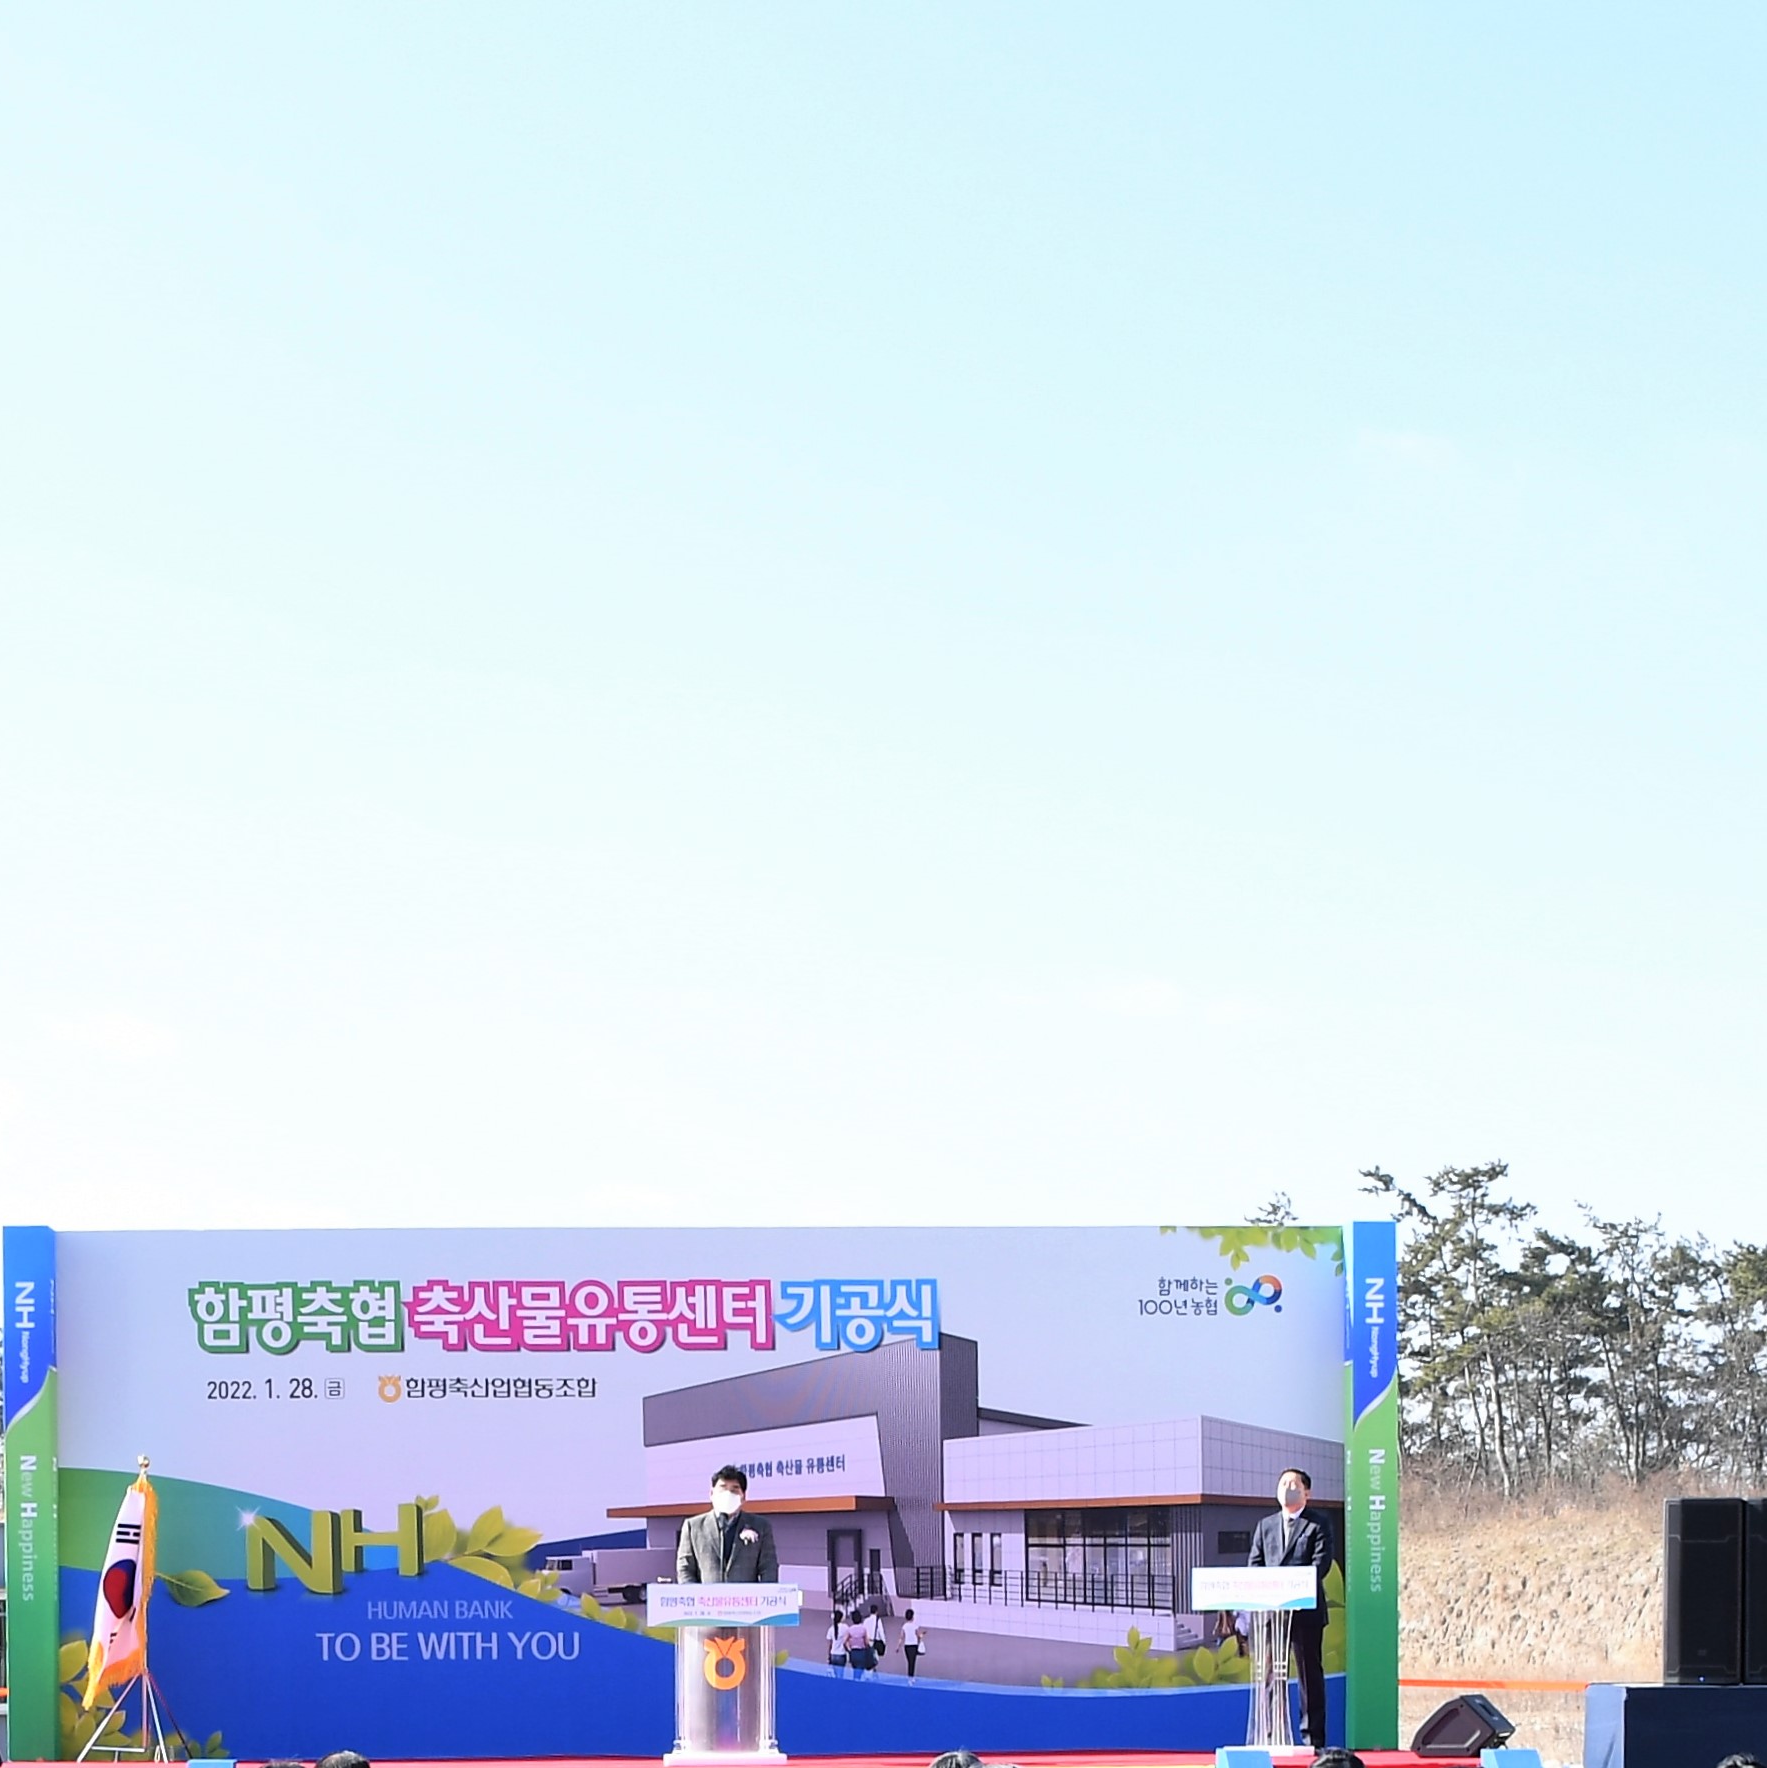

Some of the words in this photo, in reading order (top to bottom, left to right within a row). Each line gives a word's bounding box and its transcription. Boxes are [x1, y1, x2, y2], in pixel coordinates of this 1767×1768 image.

[15, 1281, 35, 1329] NH
[1157, 1275, 1219, 1297] 함께하는
[1364, 1277, 1385, 1324] NH
[191, 1283, 400, 1351] 함평축협
[409, 1282, 770, 1350] 축산물유통센터
[782, 1282, 936, 1349] 기공식
[206, 1380, 258, 1401] 2022.
[265, 1377, 281, 1400] 1.
[288, 1377, 319, 1400] 28.
[405, 1376, 597, 1400] 함평축산업협동조합
[19, 1455, 38, 1497] New
[1368, 1448, 1386, 1491] New
[18, 1502, 38, 1601] Happiness
[245, 1502, 425, 1595] NH
[1366, 1494, 1386, 1593] Happiness
[367, 1600, 449, 1620] HUMAN
[454, 1600, 514, 1620] BANK
[315, 1632, 361, 1662] TO
[370, 1632, 409, 1662] BE
[417, 1631, 499, 1661] WITH
[507, 1631, 581, 1661] YOU
